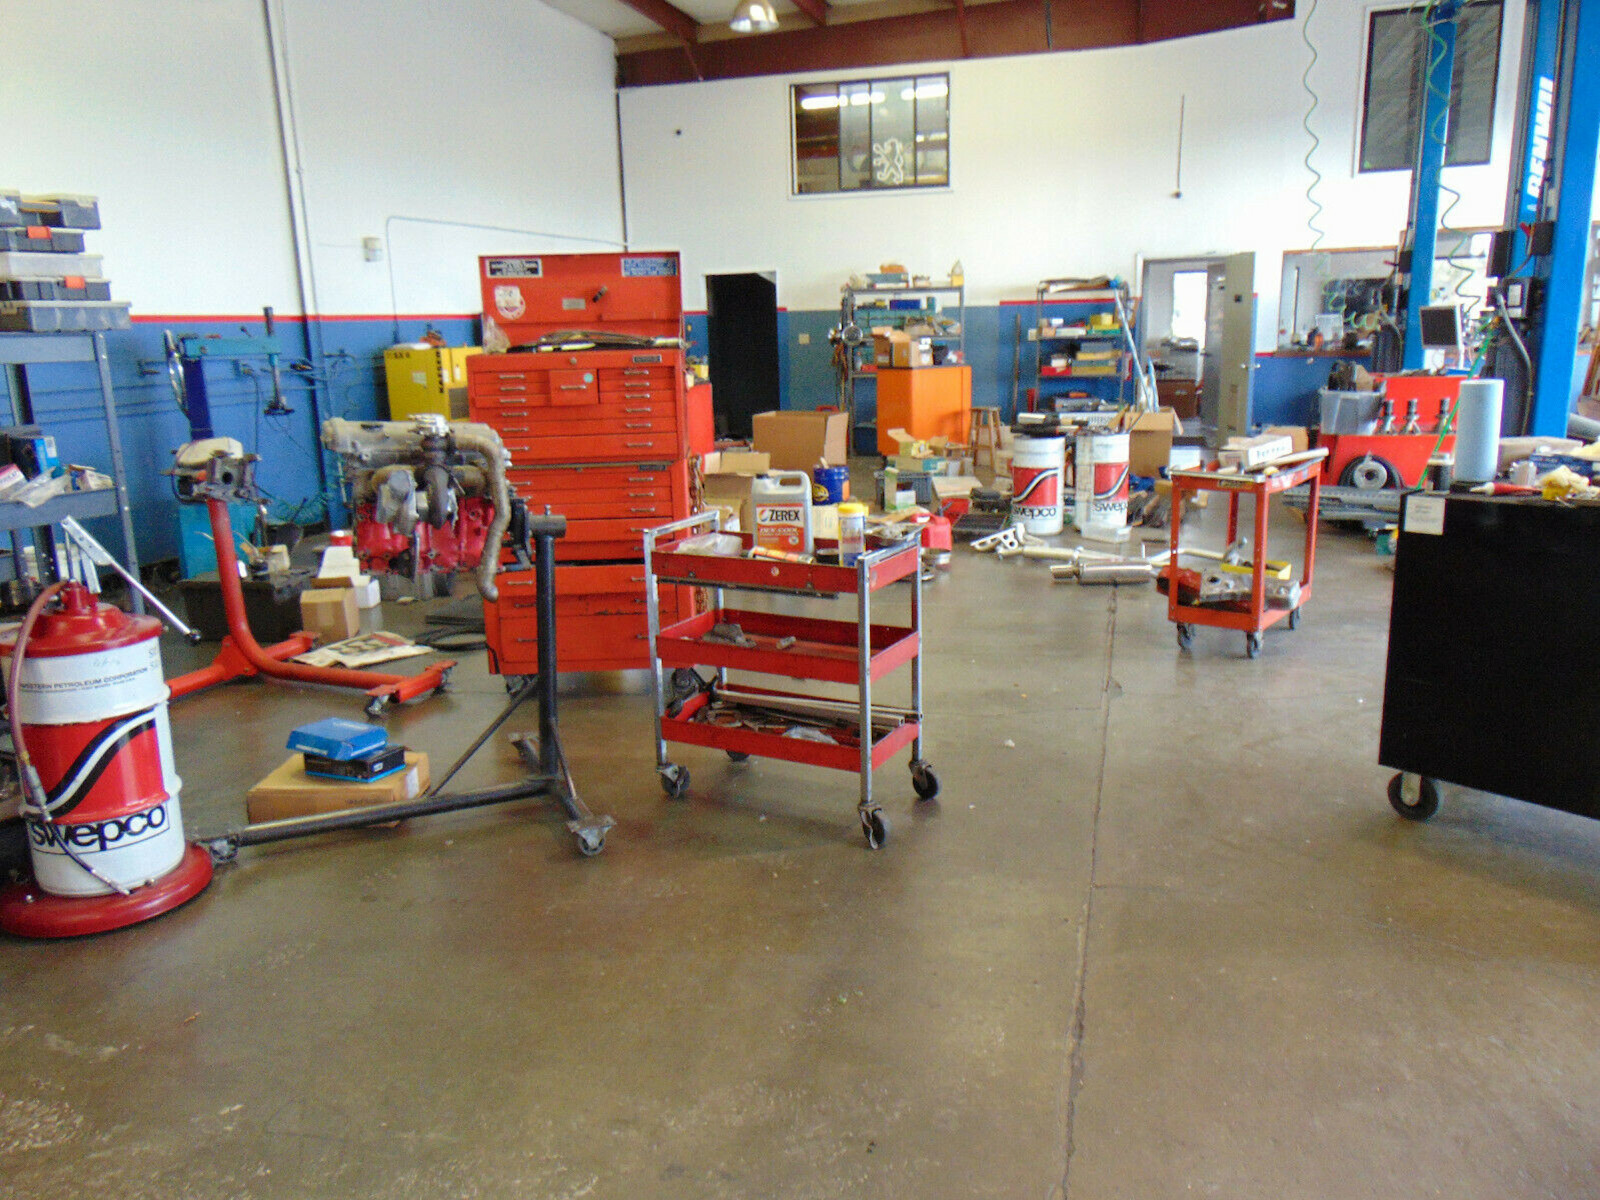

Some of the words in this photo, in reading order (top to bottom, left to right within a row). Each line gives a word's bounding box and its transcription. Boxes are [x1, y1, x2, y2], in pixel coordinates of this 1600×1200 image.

[769, 509, 800, 522] ZEREX
[53, 678, 102, 689] PETROLEUM
[103, 667, 148, 683] CORPORATION
[31, 805, 166, 851] swepco
